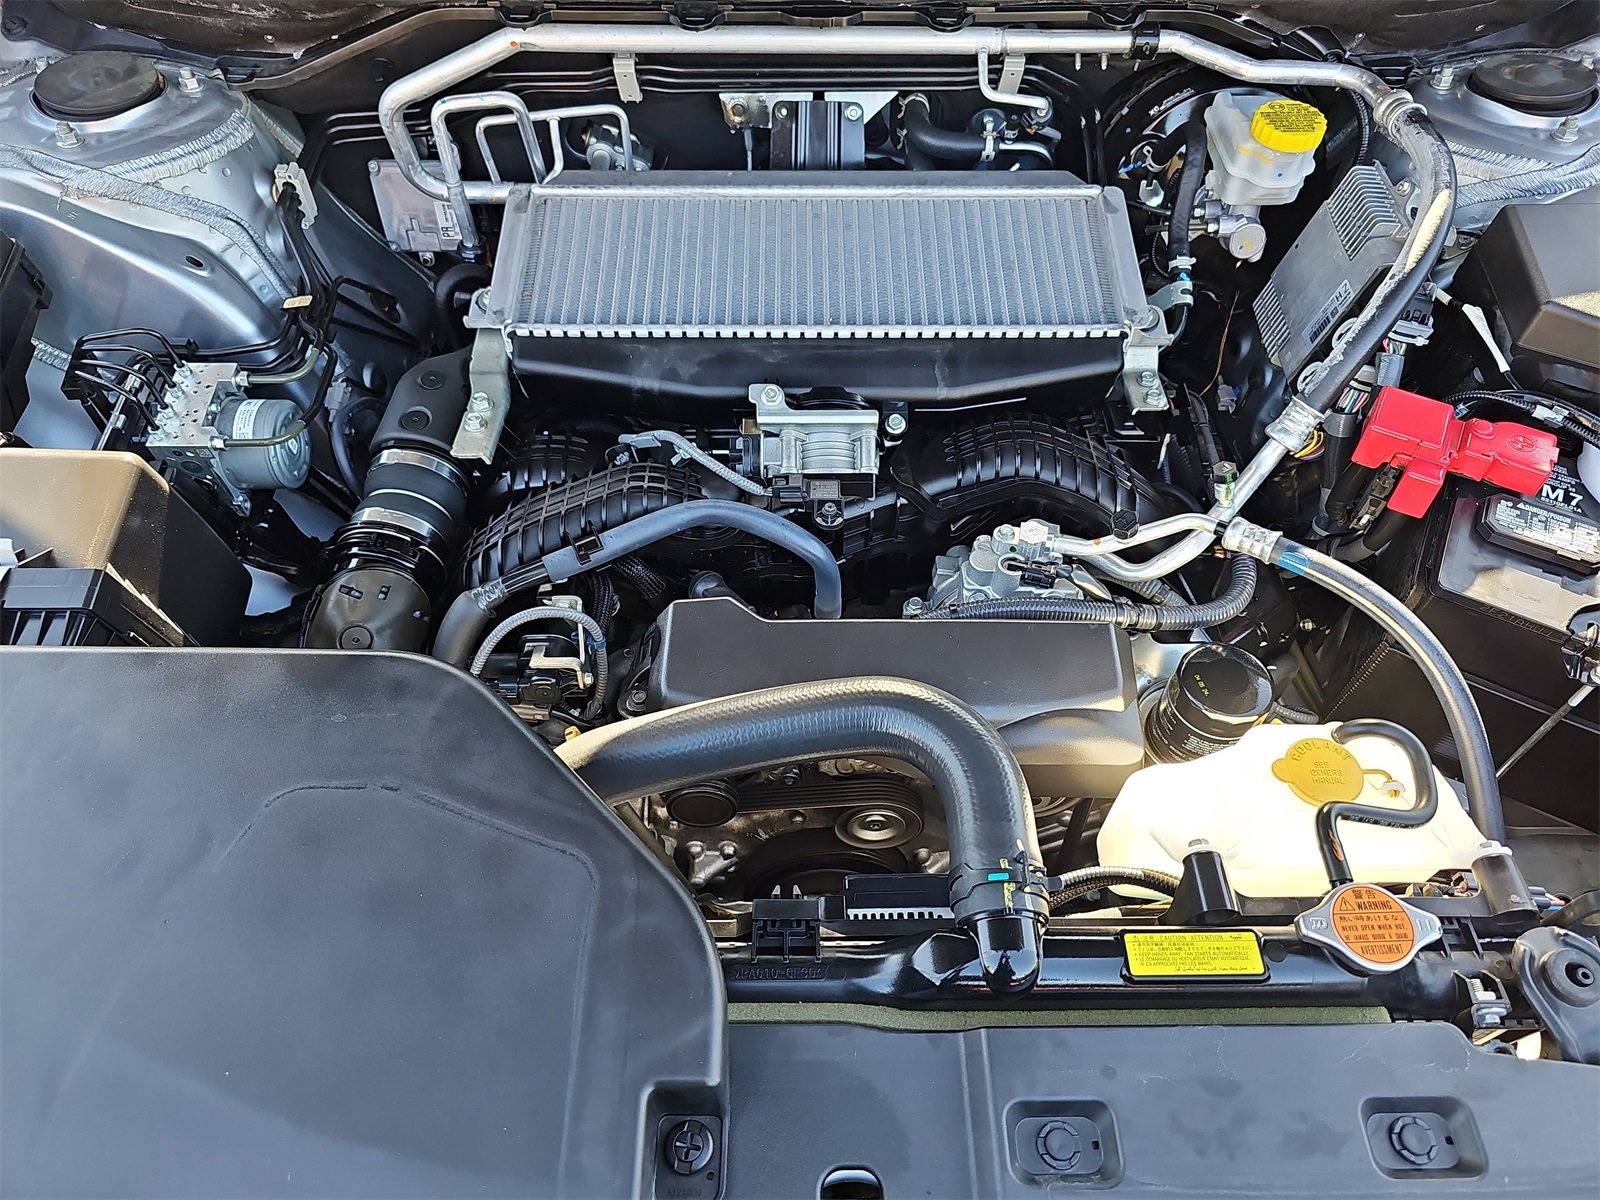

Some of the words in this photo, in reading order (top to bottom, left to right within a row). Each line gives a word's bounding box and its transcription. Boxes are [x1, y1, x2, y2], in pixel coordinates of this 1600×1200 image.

[1290, 740, 1352, 761] COOLANT
[1313, 761, 1330, 769] SEE
[1310, 768, 1344, 777] OWNERS
[1312, 776, 1346, 785] MANUAL
[1351, 889, 1377, 900] 警告
[1355, 900, 1393, 911] WARNING
